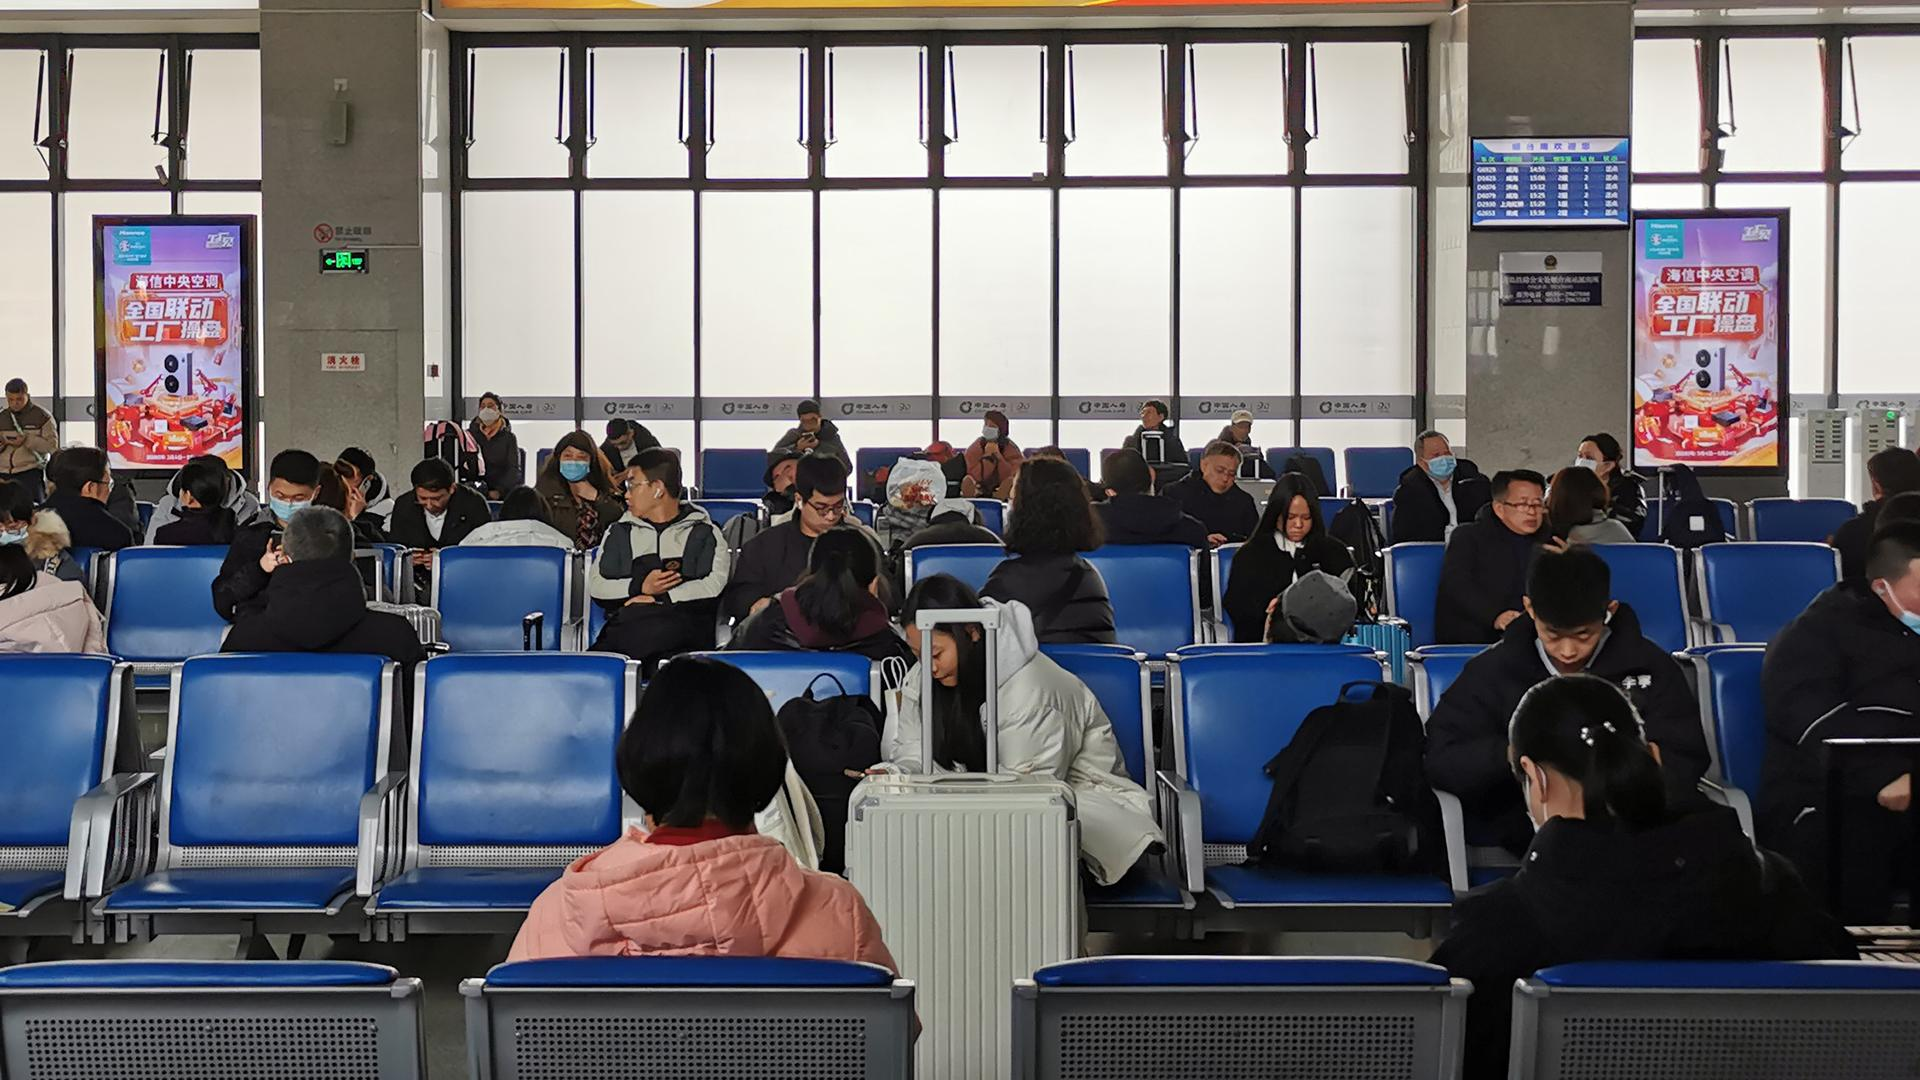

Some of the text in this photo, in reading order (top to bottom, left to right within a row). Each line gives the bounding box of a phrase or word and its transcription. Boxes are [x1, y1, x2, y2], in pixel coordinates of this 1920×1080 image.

[135, 274, 219, 289] 海信中央空调
[1666, 268, 1755, 282] 海信中央空调
[125, 298, 215, 321] 全国联动
[1655, 291, 1751, 314] 全国联动
[129, 320, 222, 343] 工厂操盘
[1659, 314, 1758, 337] 工厂操盘
[327, 355, 360, 365] 消火栓
